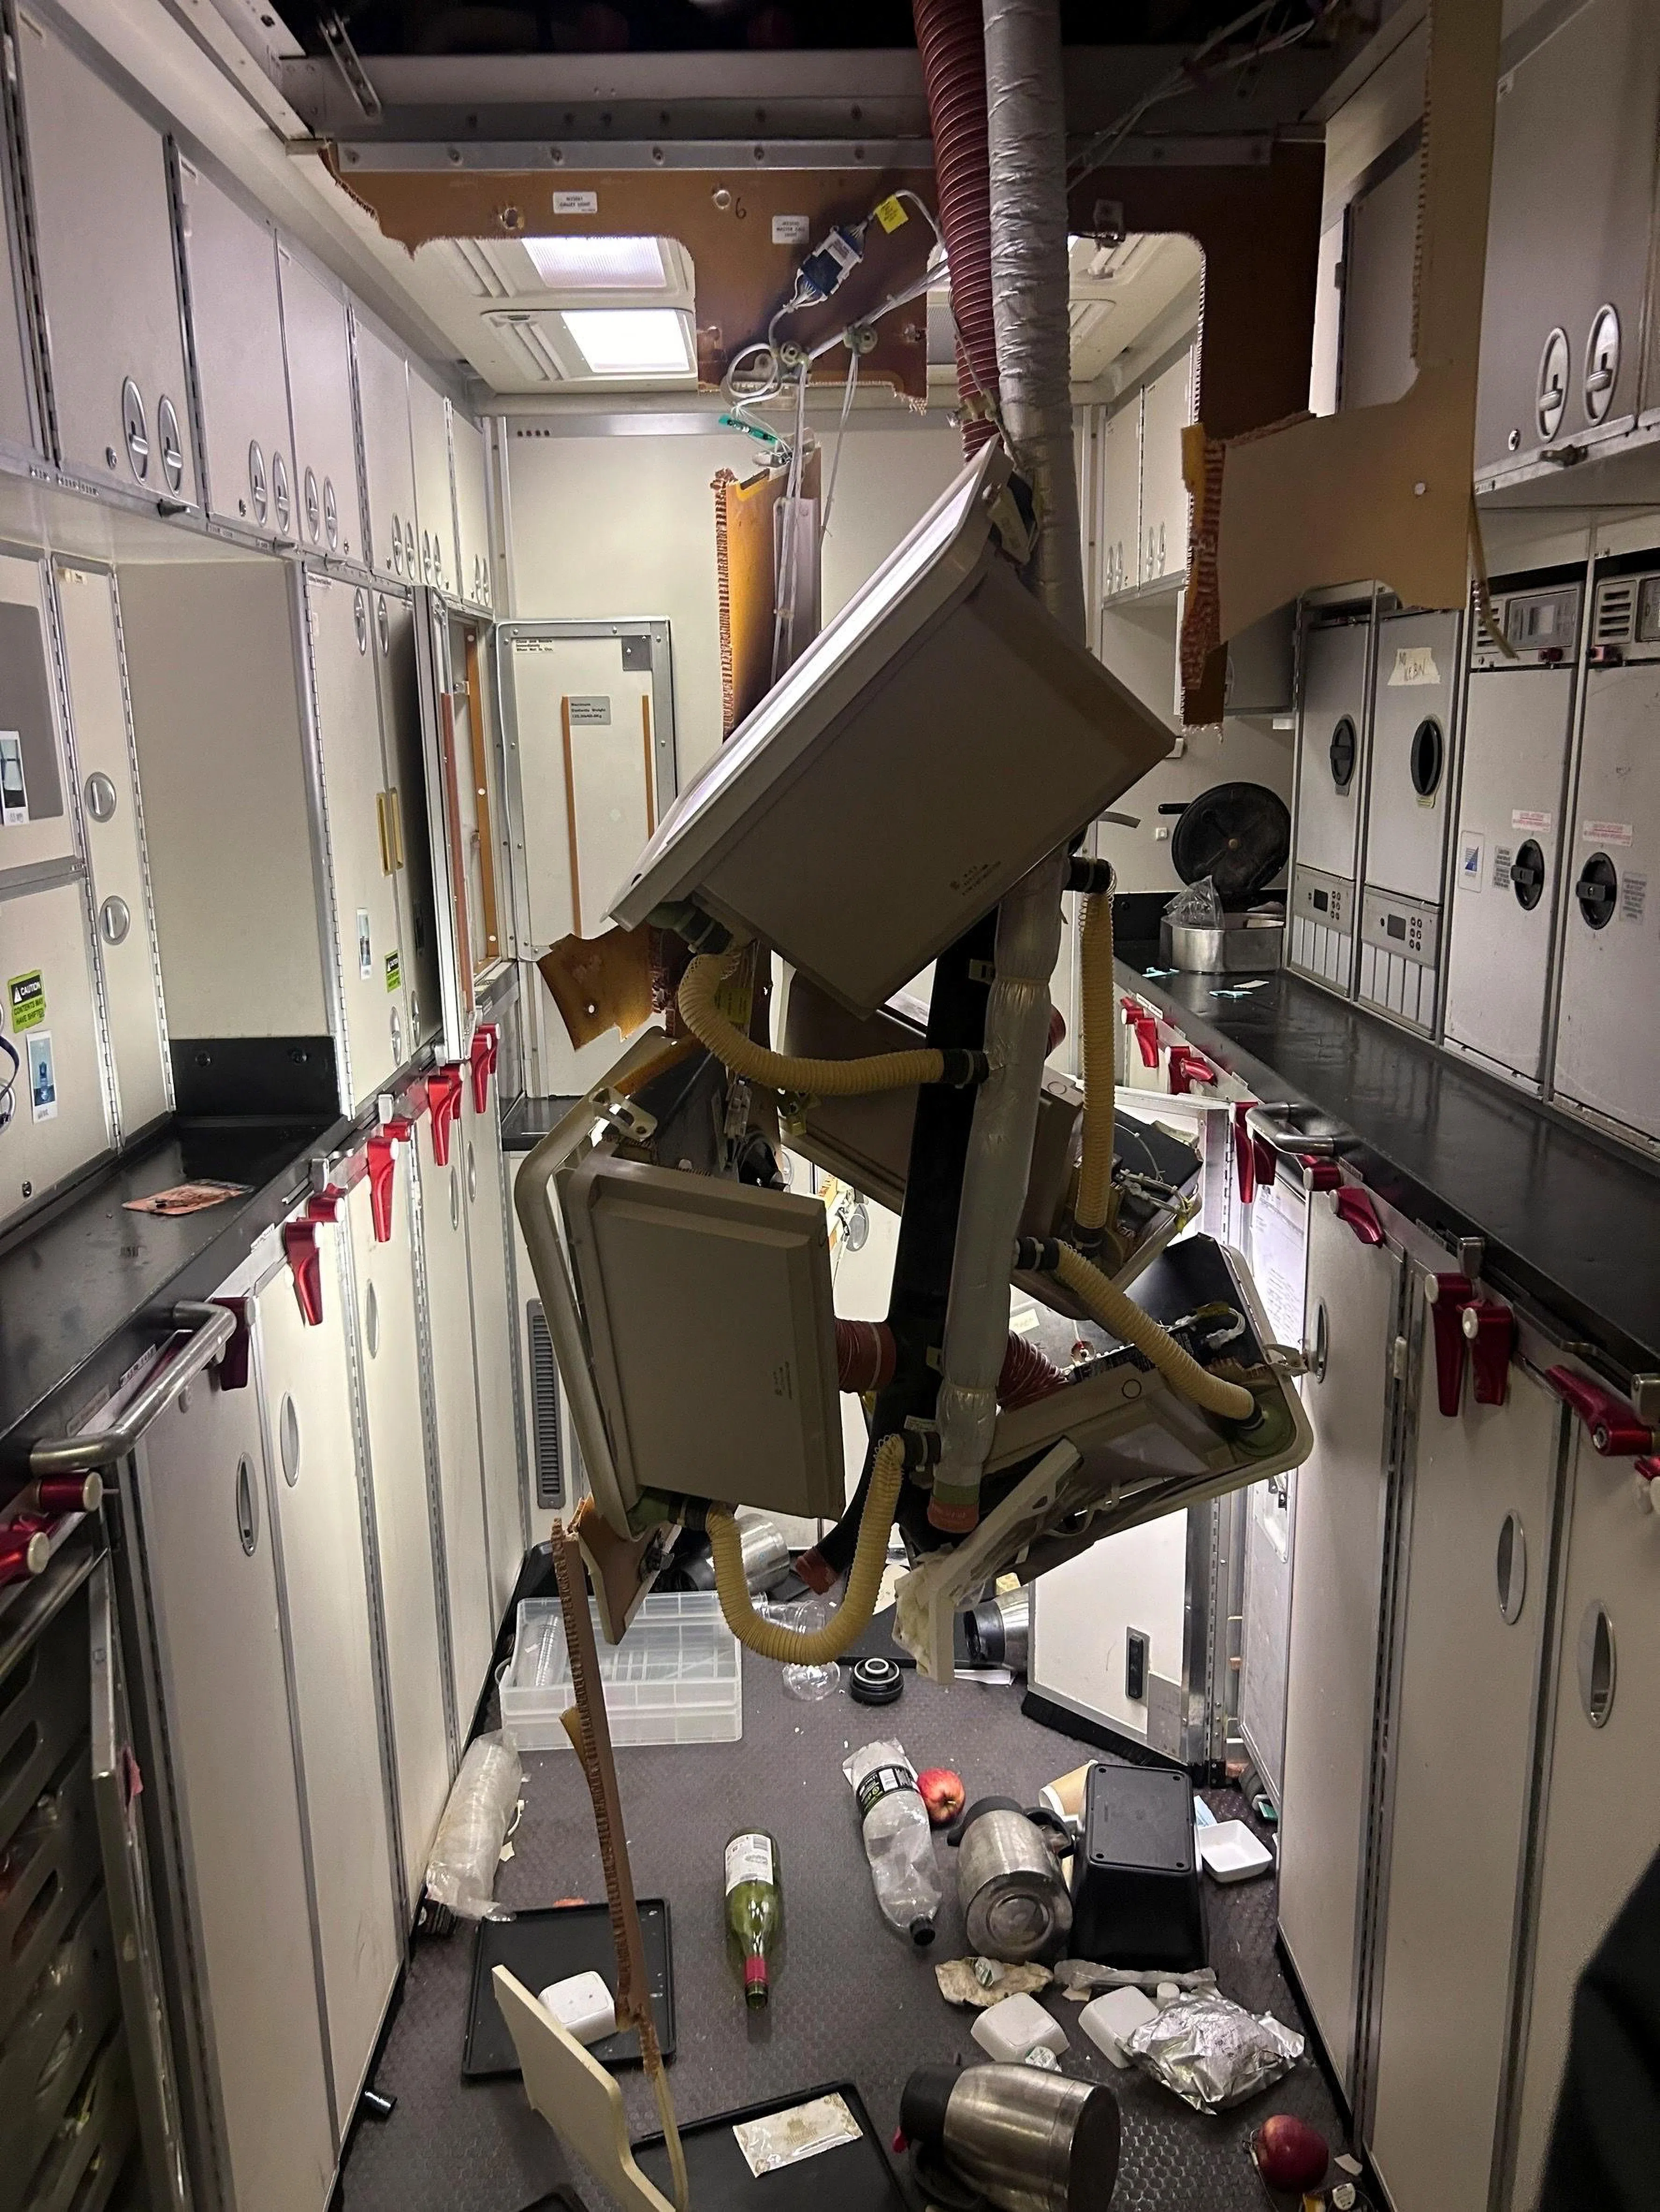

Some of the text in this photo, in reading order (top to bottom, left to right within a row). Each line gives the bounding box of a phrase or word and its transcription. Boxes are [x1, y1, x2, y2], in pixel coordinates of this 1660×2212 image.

[735, 196, 747, 219] 6
[21, 982, 41, 996] CAUTION
[14, 1001, 35, 1015] CONTENTS
